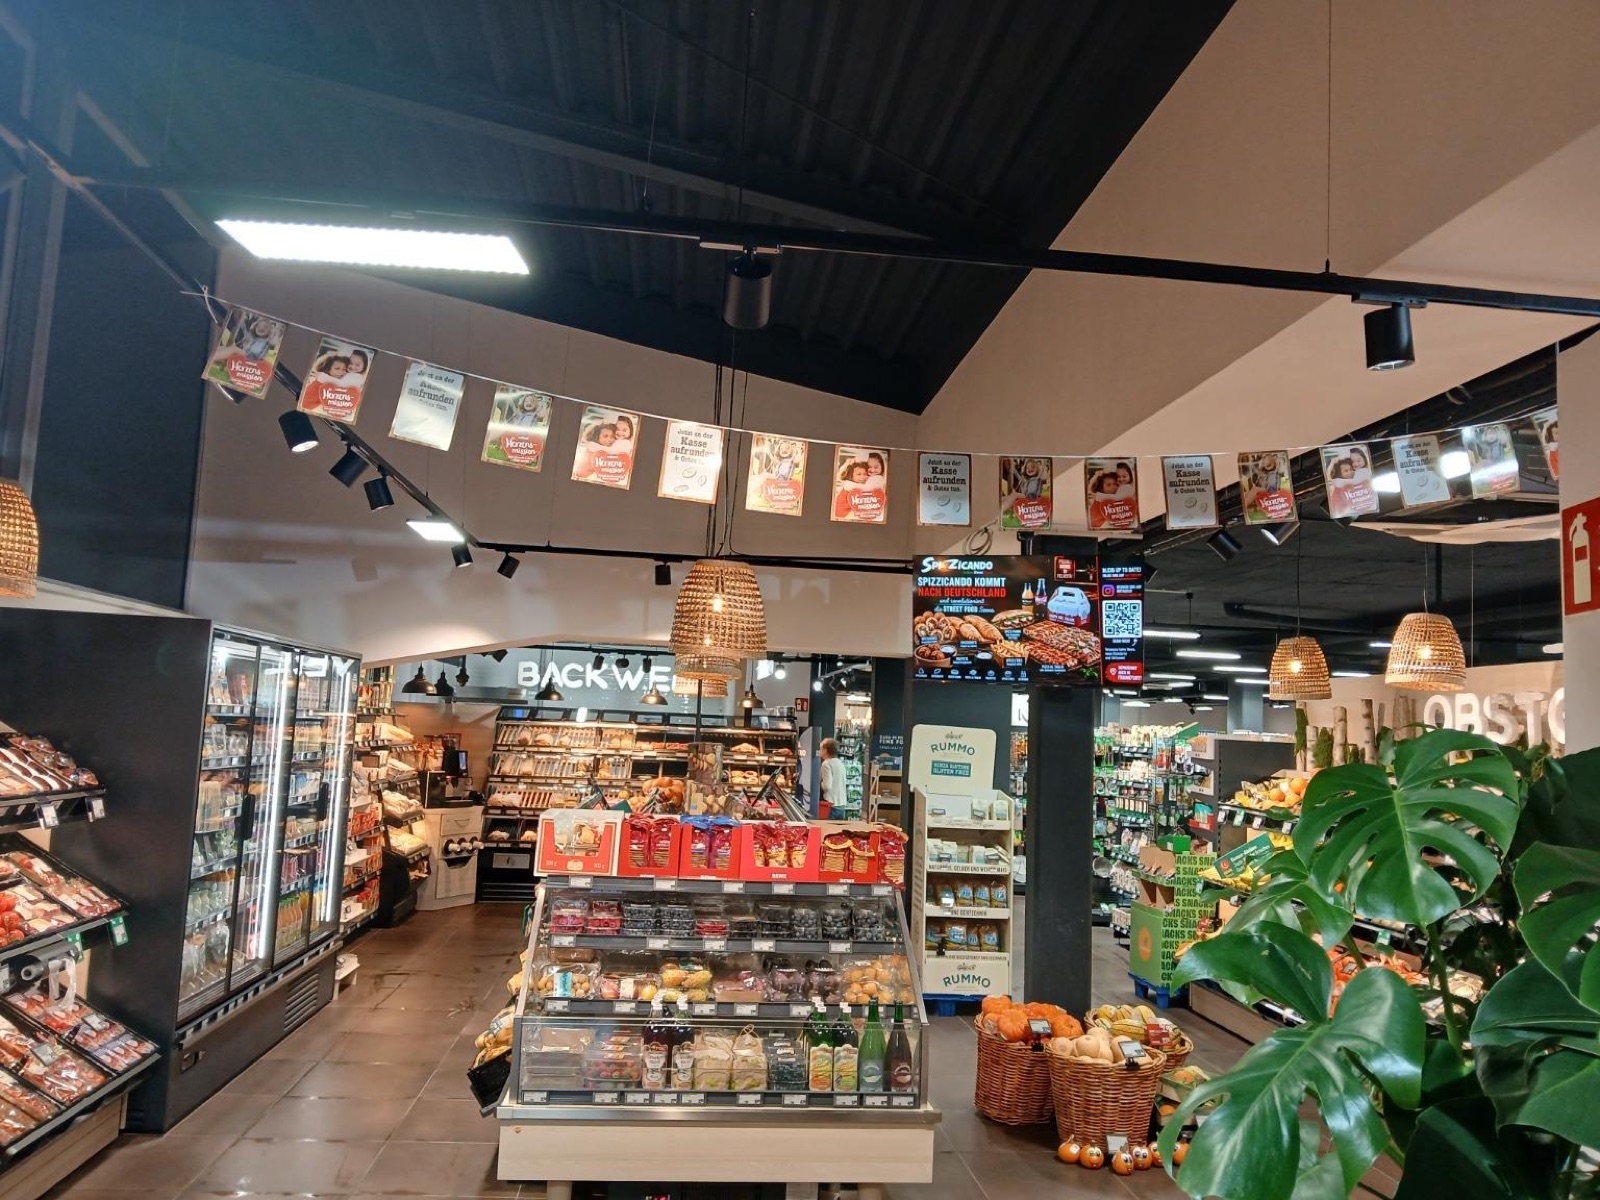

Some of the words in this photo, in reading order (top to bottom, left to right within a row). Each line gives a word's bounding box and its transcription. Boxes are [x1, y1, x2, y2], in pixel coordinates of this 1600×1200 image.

[322, 388, 355, 402] Herzens-
[408, 387, 455, 406] aufrunden
[702, 432, 713, 440] der
[506, 437, 537, 450] Herzens-
[680, 436, 708, 449] Kasse
[670, 445, 716, 458] aufrunde
[1405, 448, 1429, 458] Kasse
[1399, 457, 1434, 469] aufrund
[931, 466, 957, 476] Kasse
[1175, 469, 1201, 478] Kasse
[922, 475, 967, 485] aufrunden
[1169, 477, 1210, 488] aufrunden
[921, 557, 993, 573] SPIZICANDO
[917, 576, 972, 587] SPIZZICANDO
[974, 577, 1006, 587] KOMMT
[917, 587, 942, 597] NACH
[944, 587, 1006, 597] DEUTSCHLAND
[943, 605, 963, 613] STREET
[964, 605, 978, 613] FOOD
[517, 660, 677, 692] BACKWE
[930, 742, 975, 756] RUMMO
[943, 973, 991, 988] RUMMO
